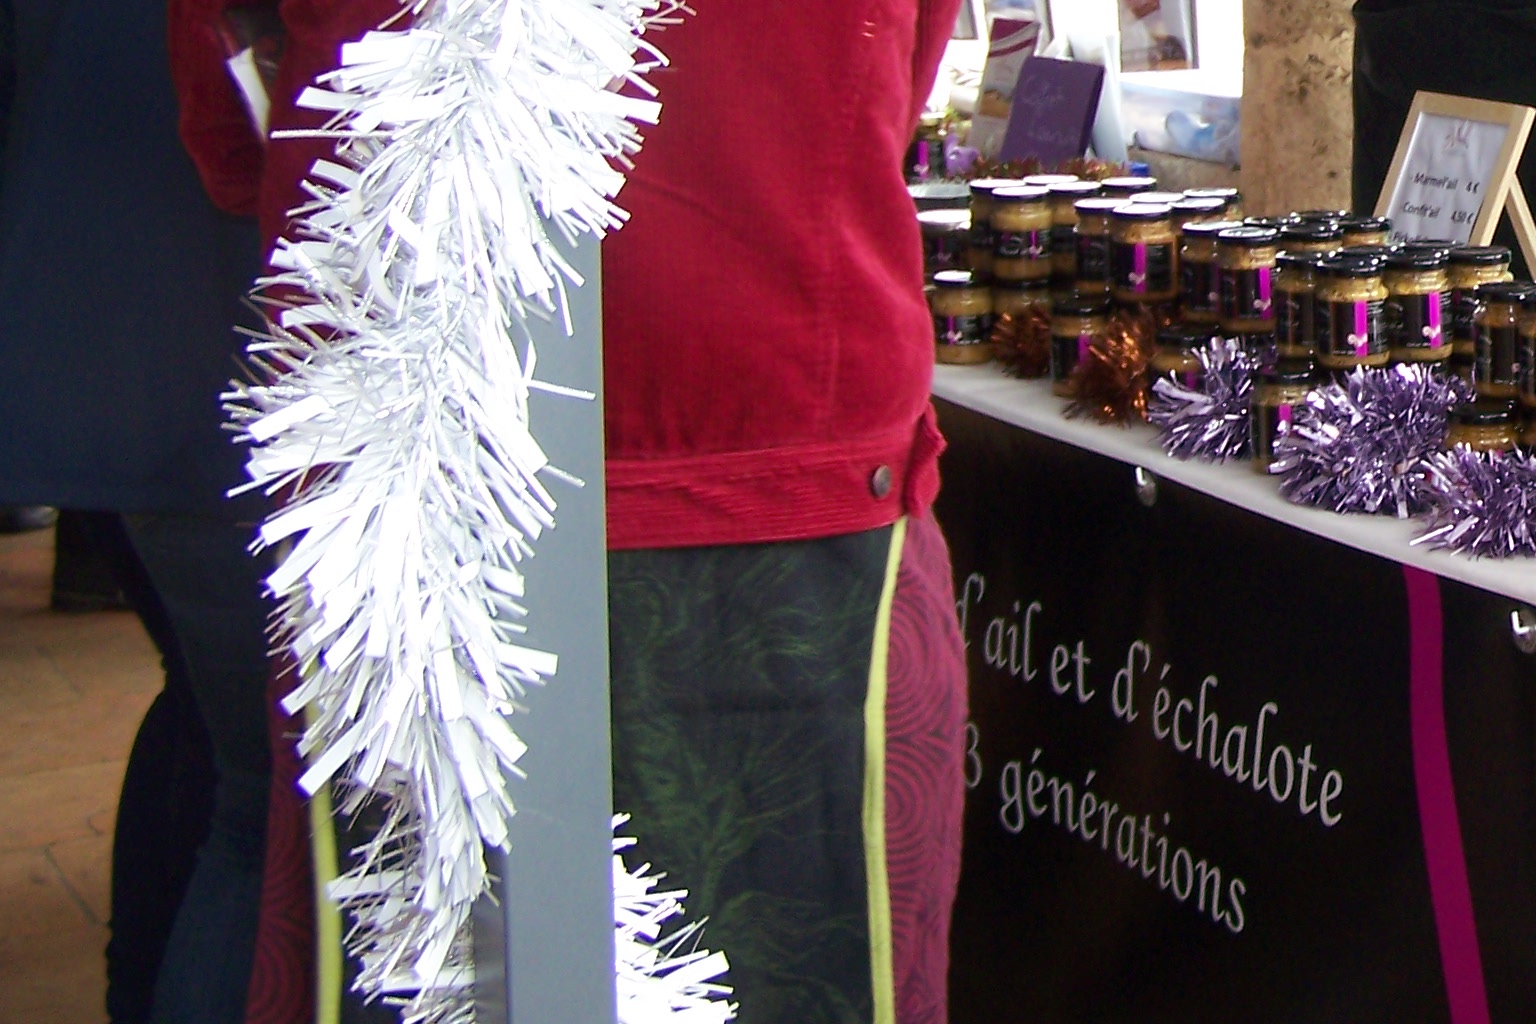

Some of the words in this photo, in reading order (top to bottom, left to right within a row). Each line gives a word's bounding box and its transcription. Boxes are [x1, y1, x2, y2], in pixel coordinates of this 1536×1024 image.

[1050, 639, 1096, 705] et
[1111, 639, 1345, 828] d'échalote
[1000, 747, 1248, 934] générations
